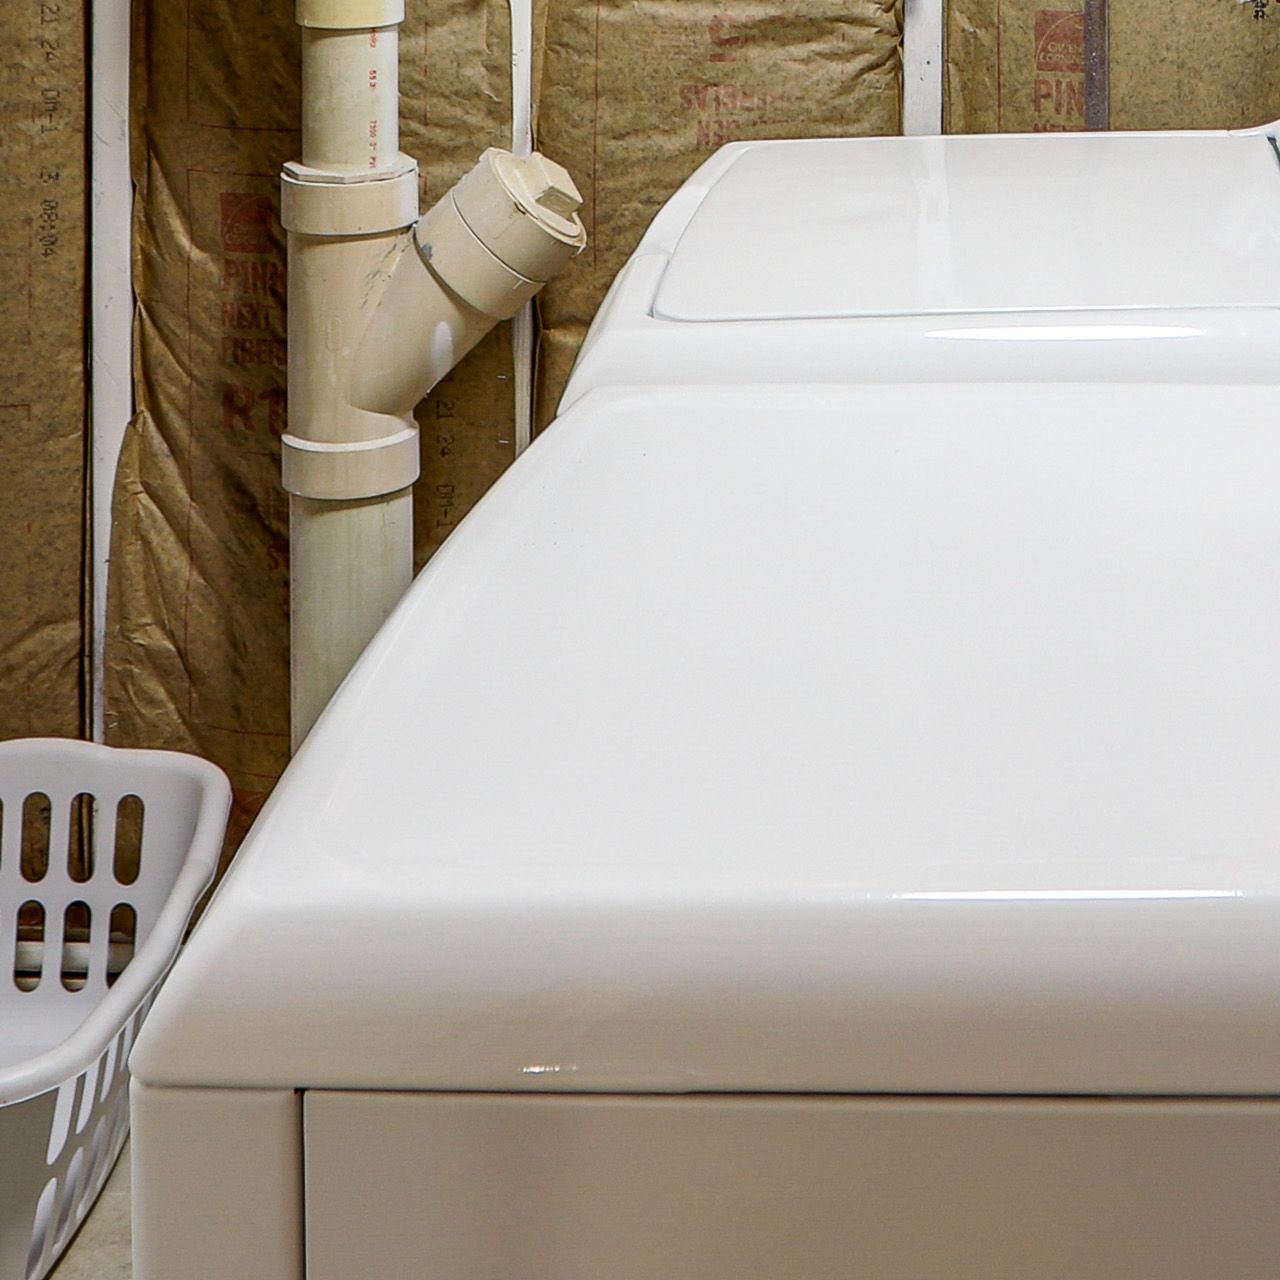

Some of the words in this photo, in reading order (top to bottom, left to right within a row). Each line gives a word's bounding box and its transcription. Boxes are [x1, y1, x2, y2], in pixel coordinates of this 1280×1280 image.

[40, 4, 61, 26] 21
[40, 41, 61, 65] 24
[40, 89, 61, 135] DM-1
[1034, 78, 1086, 116] PIN
[39, 199, 60, 258] 08:04
[221, 384, 287, 436] R1
[436, 434, 456, 458] 24
